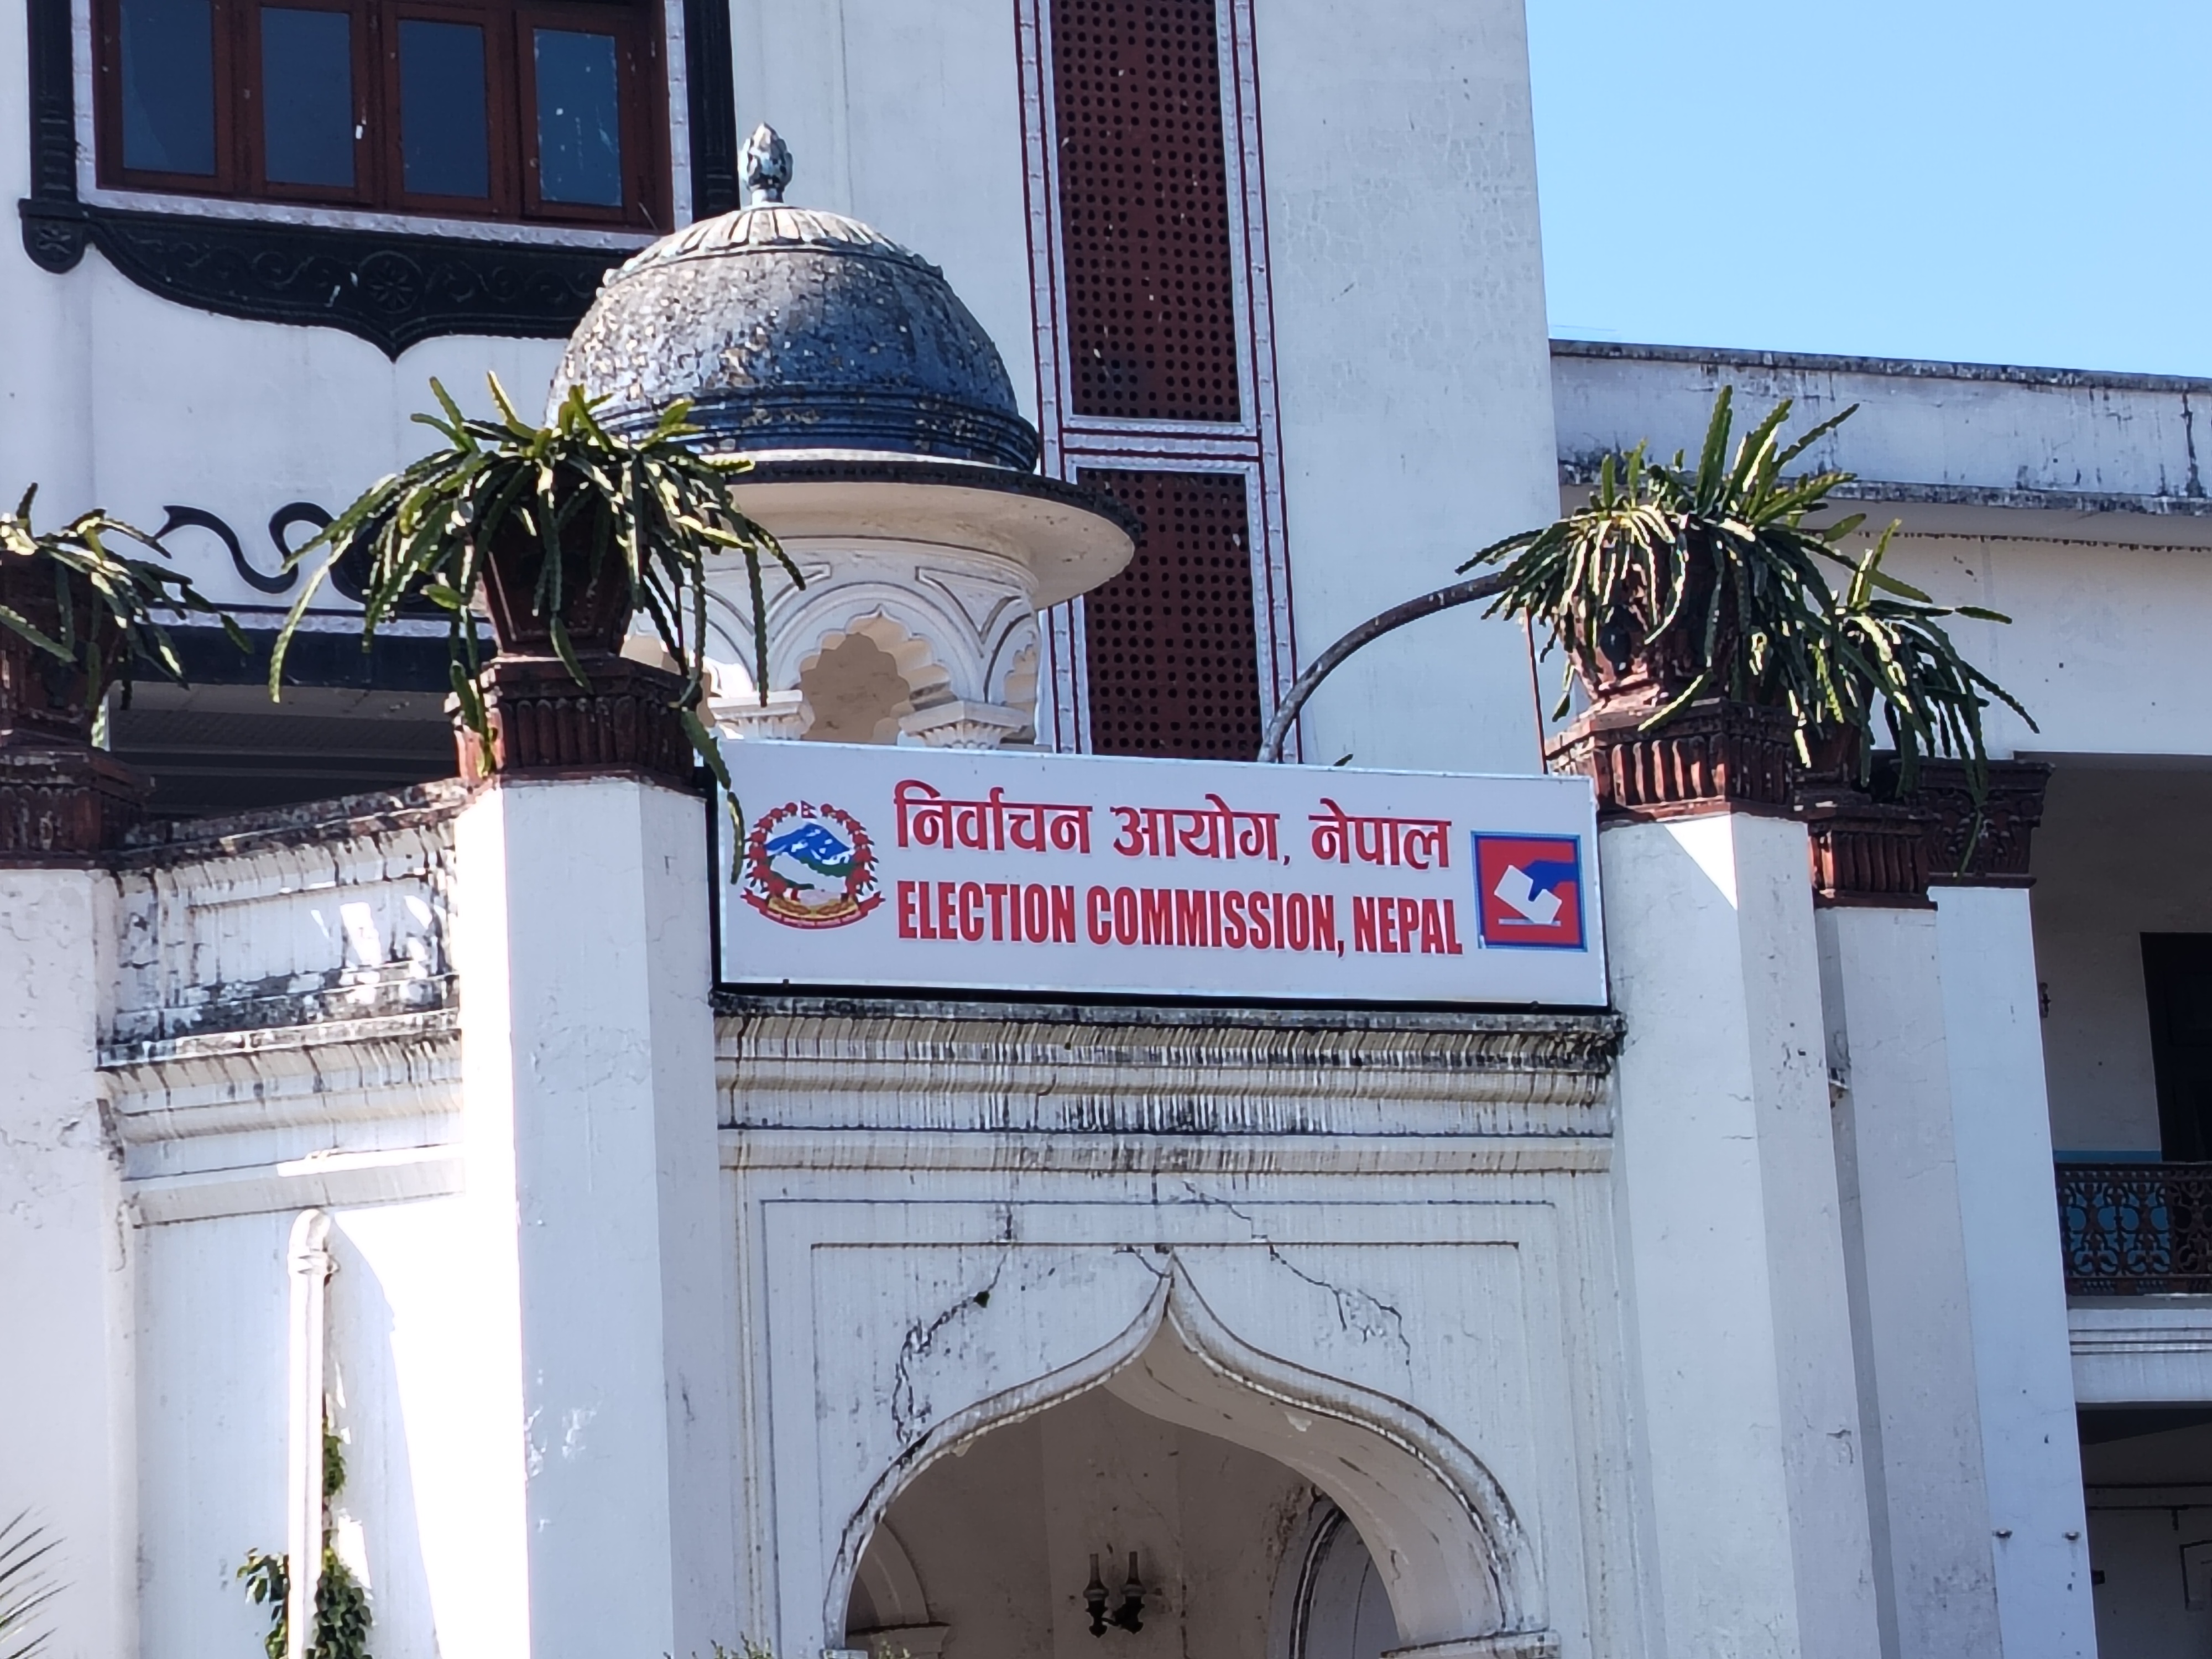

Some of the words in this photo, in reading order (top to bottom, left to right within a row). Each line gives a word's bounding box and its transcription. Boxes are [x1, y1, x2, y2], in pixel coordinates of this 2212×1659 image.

[894, 780, 1093, 854] निर्वाचन
[1110, 793, 1291, 866] आयोग,
[1308, 798, 1452, 870] नेपाल
[896, 880, 1076, 944] ELECTION
[1086, 886, 1345, 958] COMMISSION,
[1352, 896, 1463, 955] NEPAL
